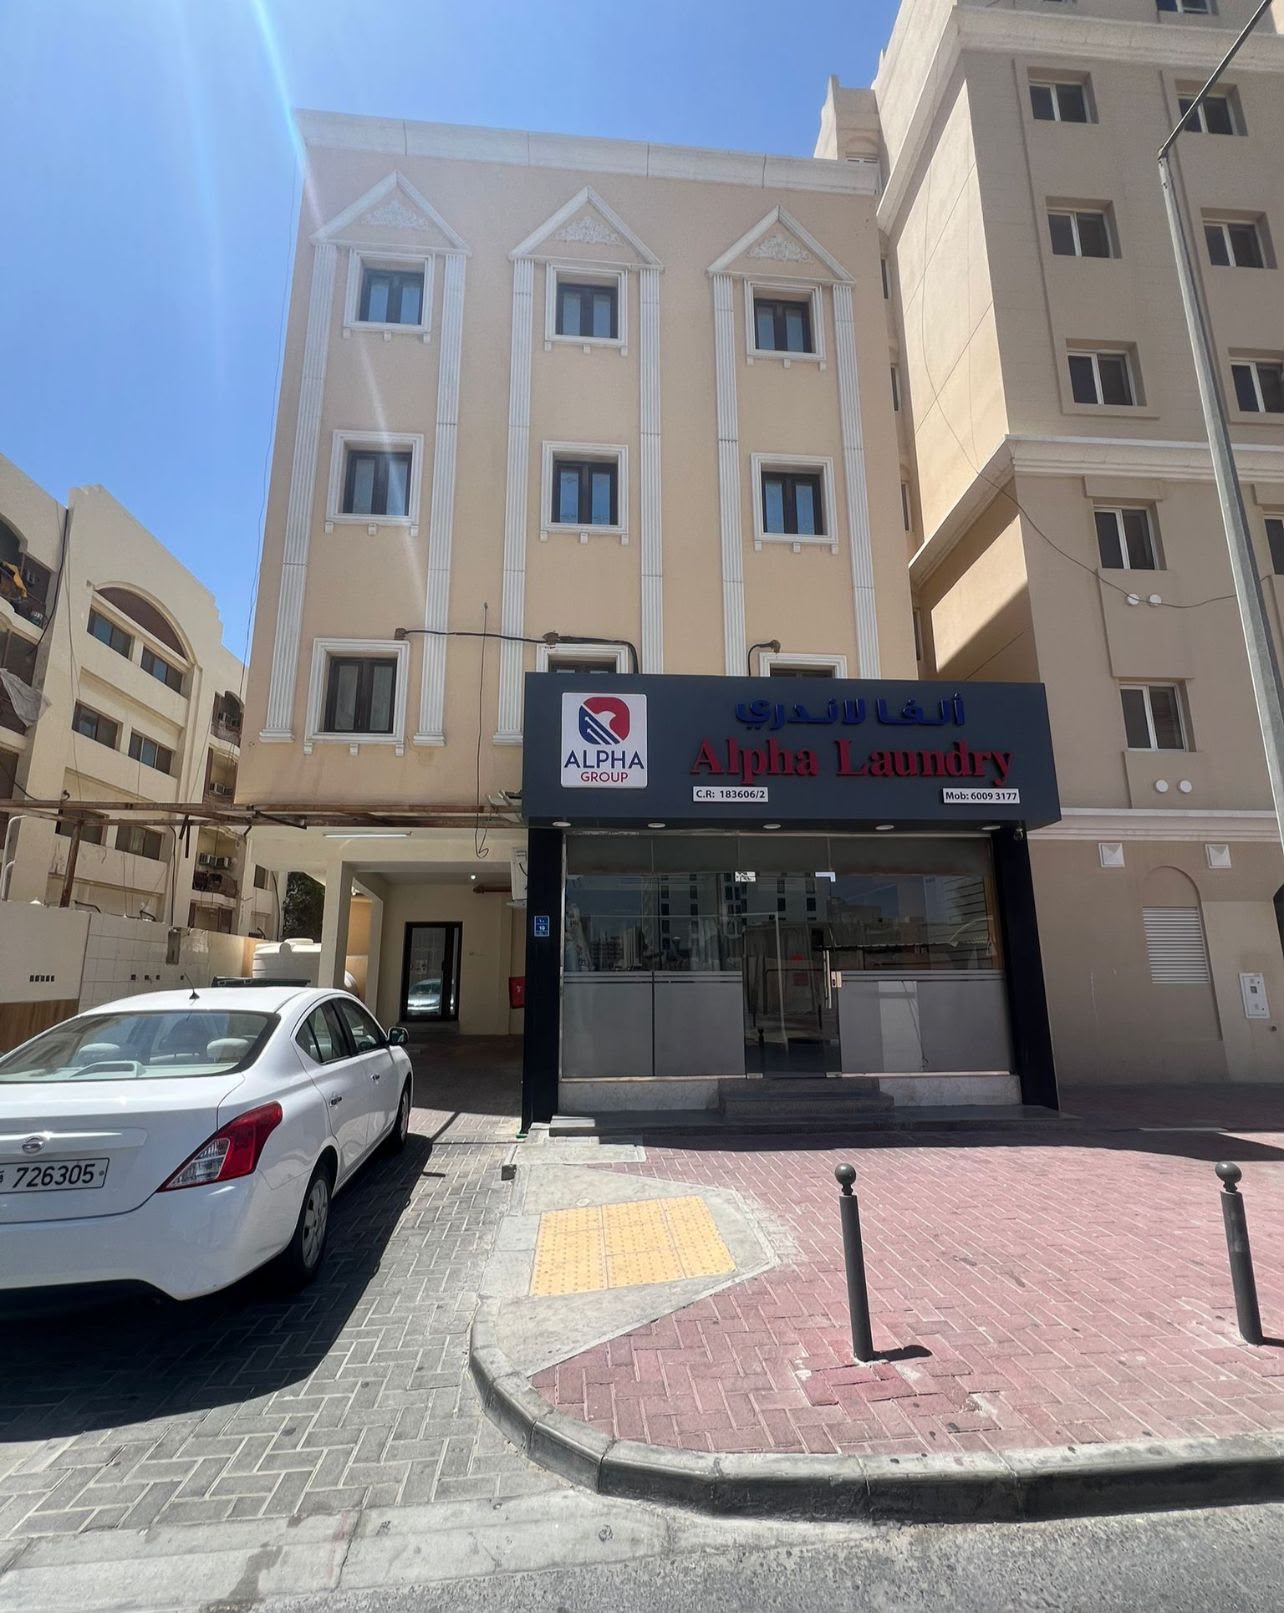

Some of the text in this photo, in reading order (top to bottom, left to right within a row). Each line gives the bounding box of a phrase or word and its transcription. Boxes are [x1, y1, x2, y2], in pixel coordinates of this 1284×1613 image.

[735, 692, 966, 731] ألفا لاندري
[564, 749, 645, 769] ALPHA
[690, 737, 1012, 786] Alpha Laundry
[580, 771, 629, 783] GROUP
[696, 789, 766, 799] C.R: 183606/2
[945, 791, 1017, 801] Mob: 6009 3177
[12, 1163, 96, 1189] 726305
